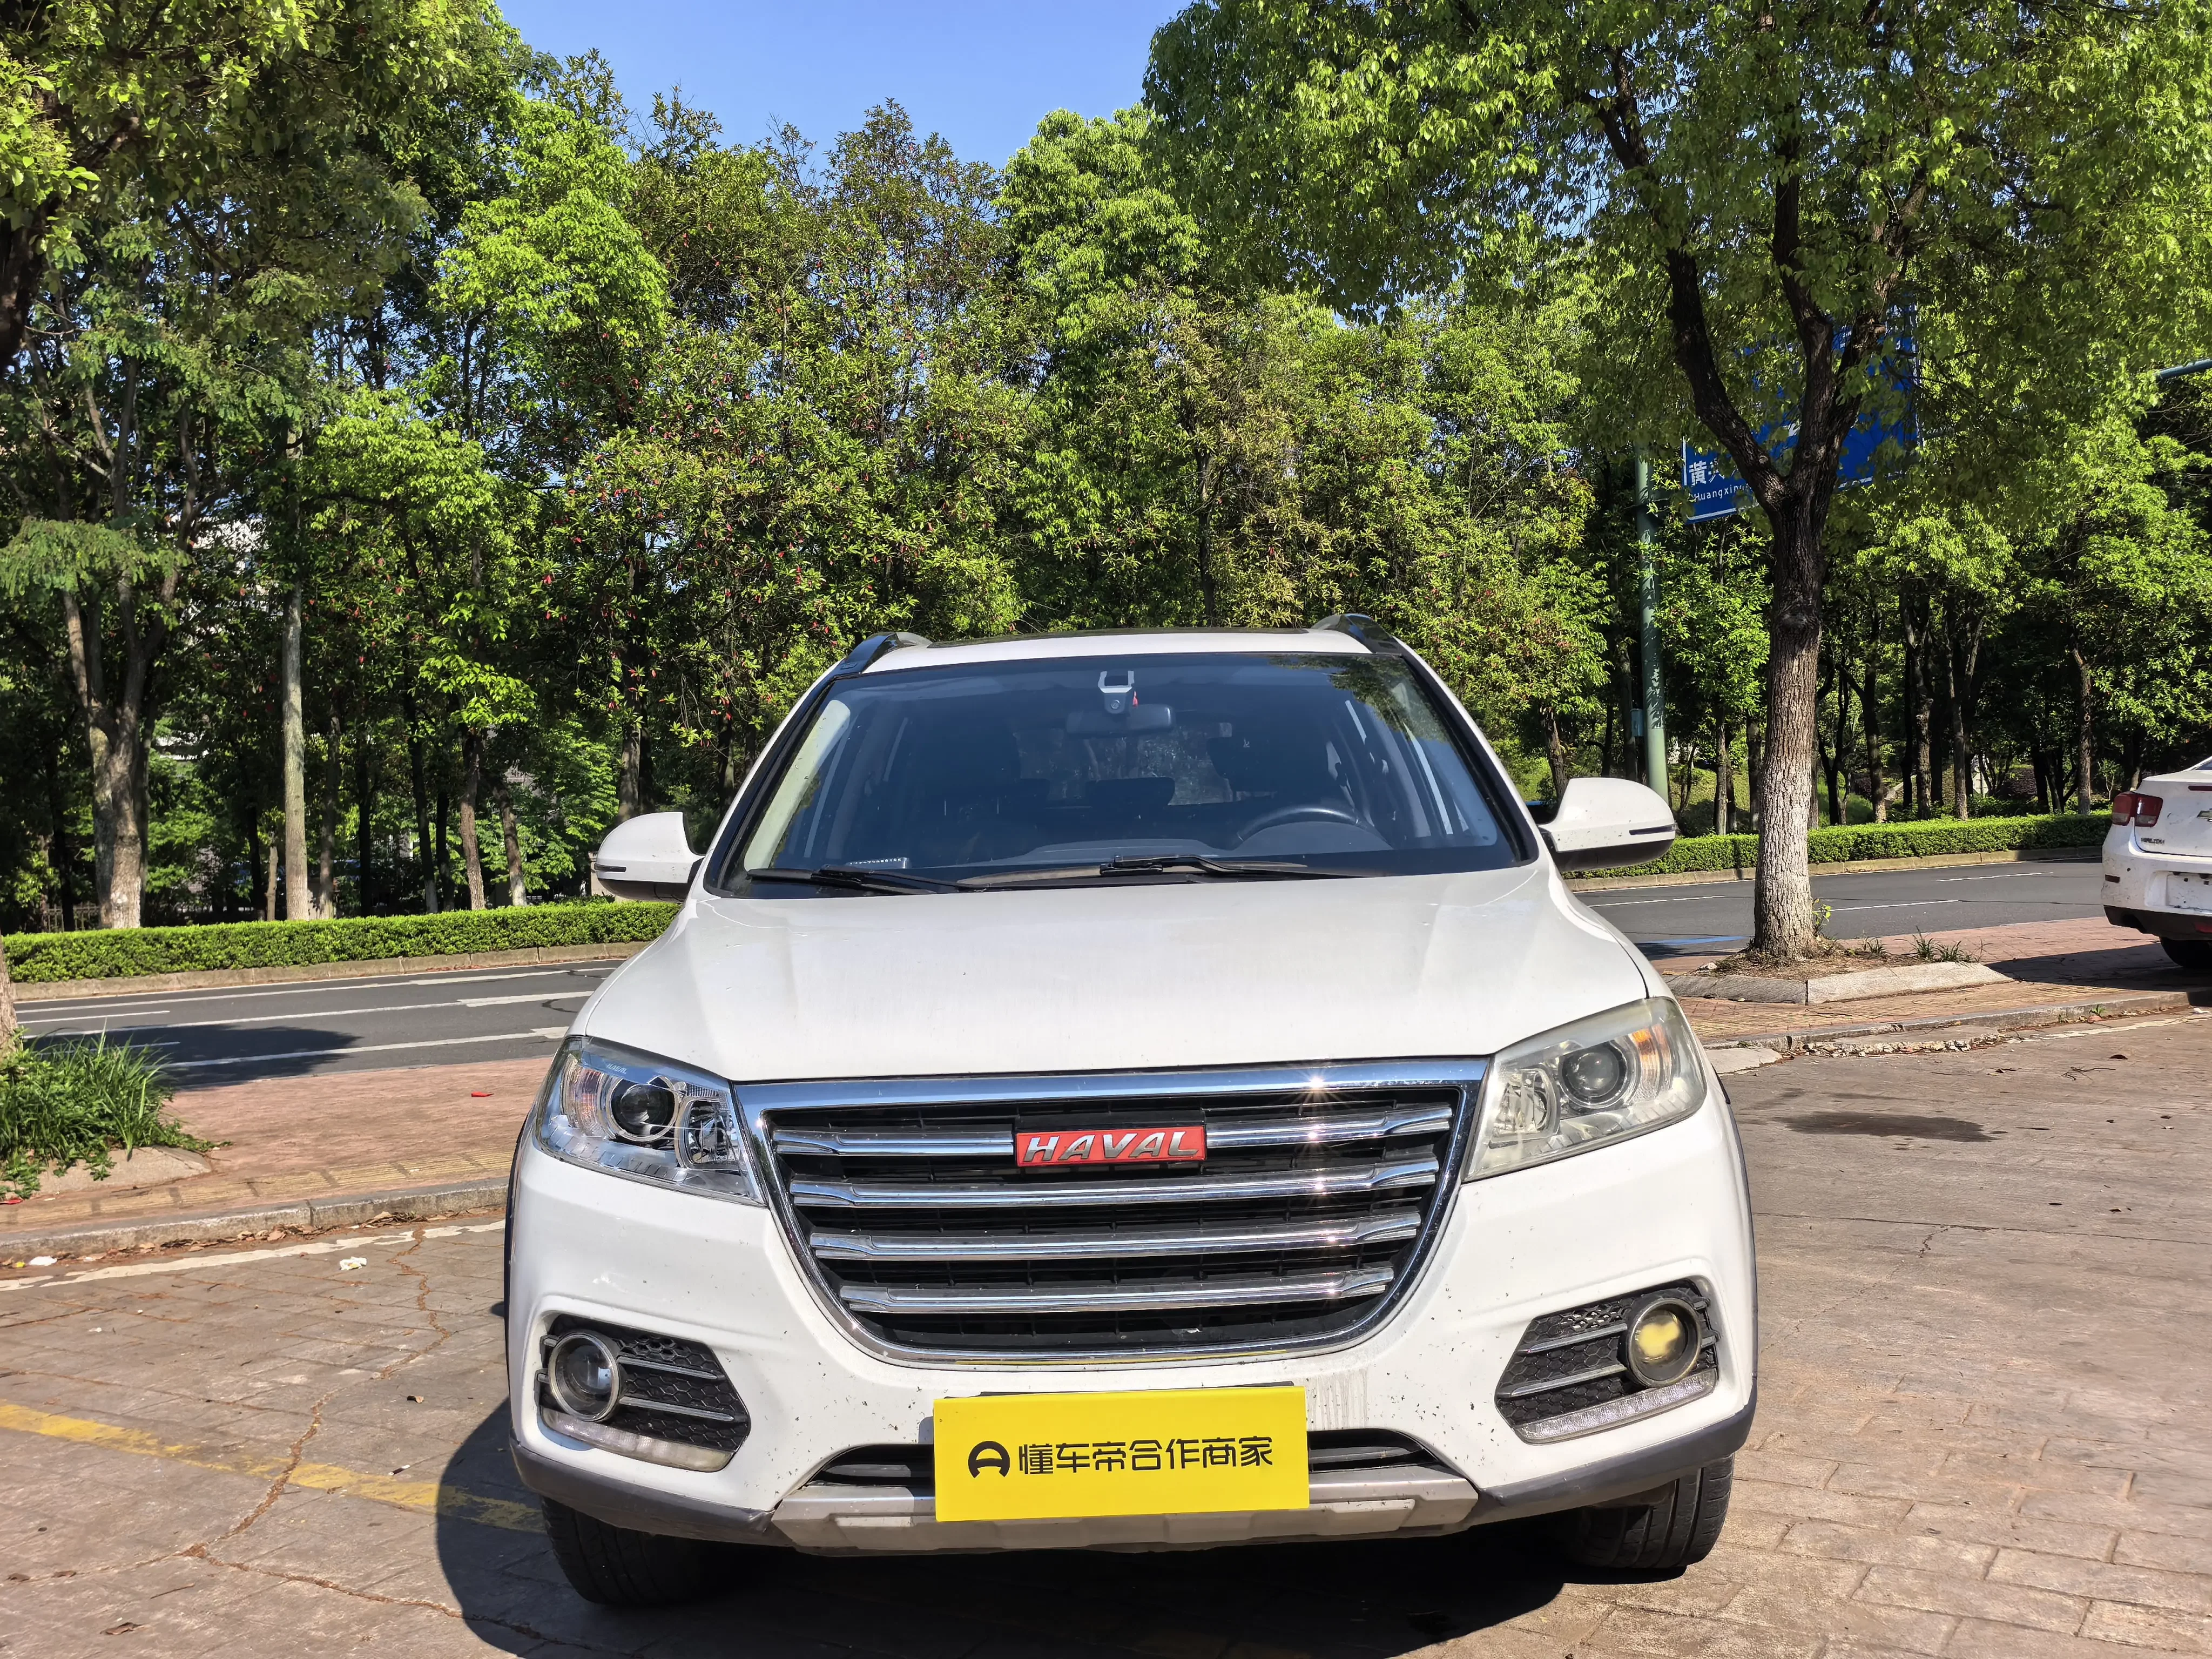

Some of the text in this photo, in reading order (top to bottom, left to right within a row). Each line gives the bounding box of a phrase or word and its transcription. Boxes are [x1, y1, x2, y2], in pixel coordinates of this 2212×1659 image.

[1023, 1131, 1199, 1162] HAVAL
[1019, 1435, 1273, 1475] 懂车帝合作商家
